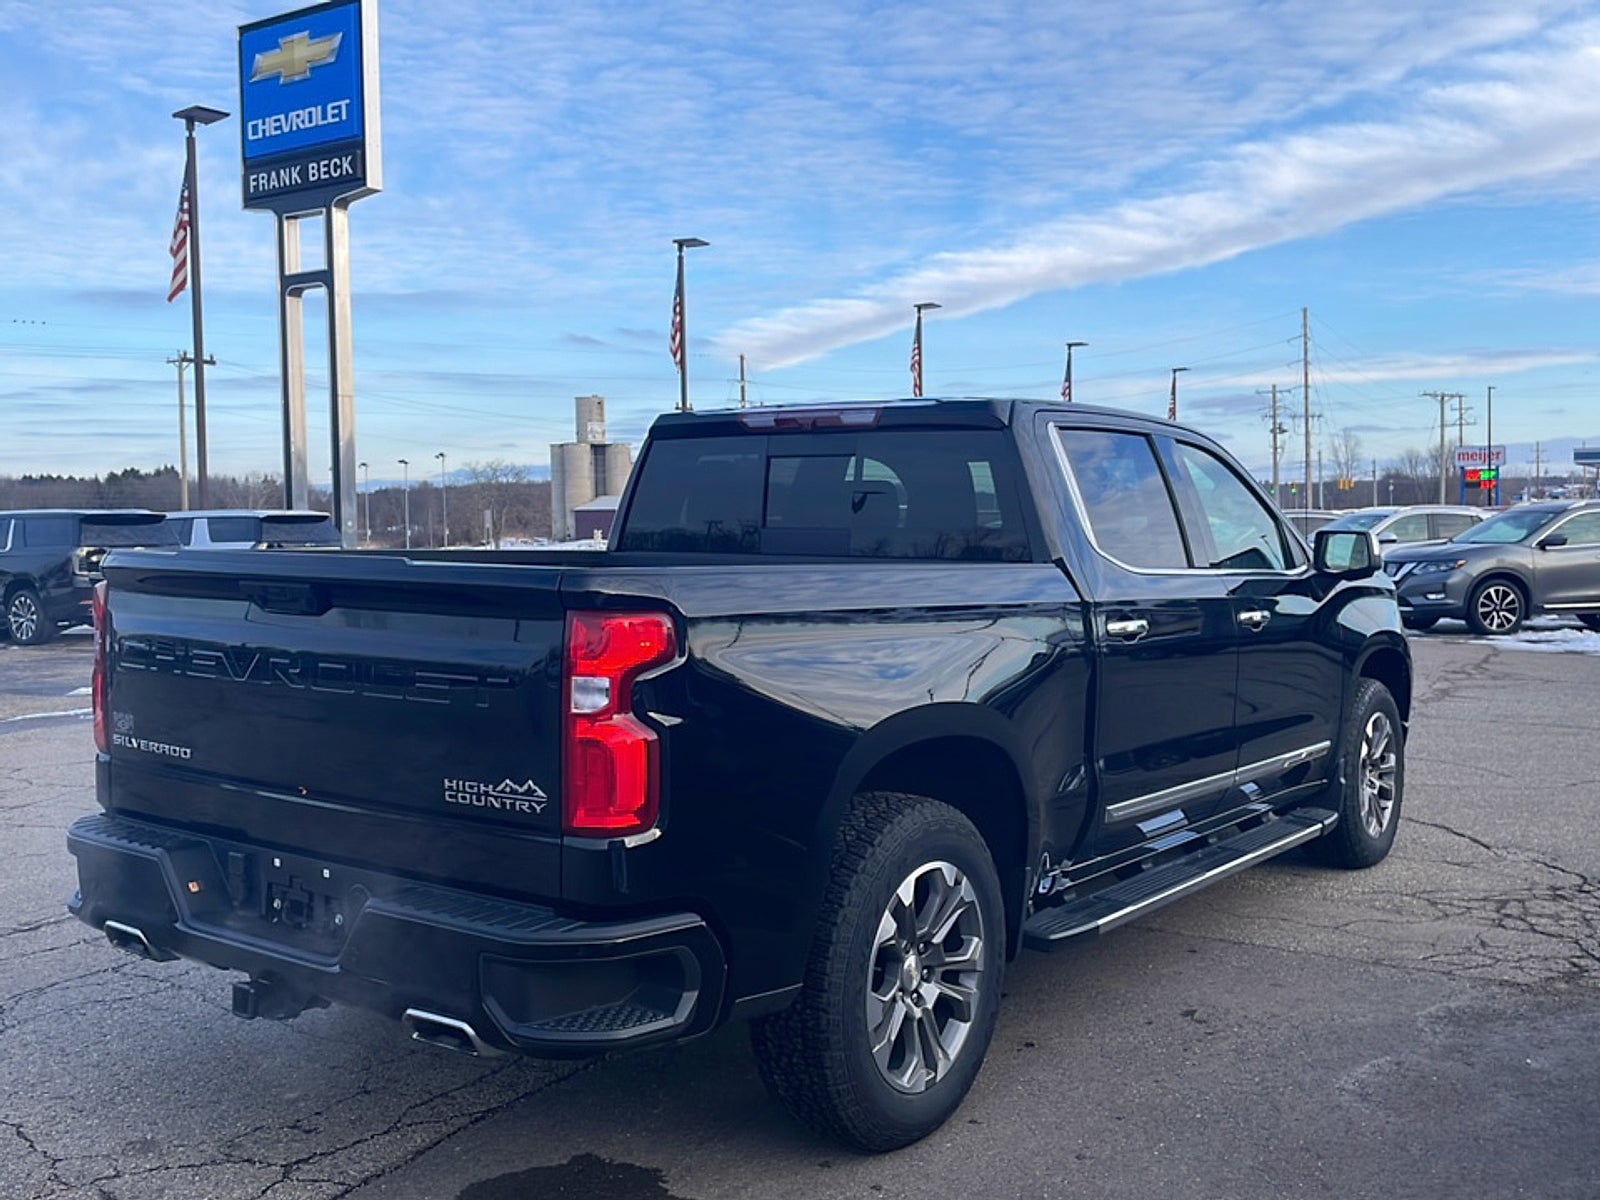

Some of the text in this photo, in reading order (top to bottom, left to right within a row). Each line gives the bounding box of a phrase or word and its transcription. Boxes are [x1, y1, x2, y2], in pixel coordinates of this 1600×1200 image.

[248, 99, 350, 140] CHEVROLET
[250, 155, 353, 193] FRANK BECK
[112, 733, 192, 759] SILVERADO
[443, 778, 494, 794] HIGH
[444, 791, 548, 814] COUNTRY
